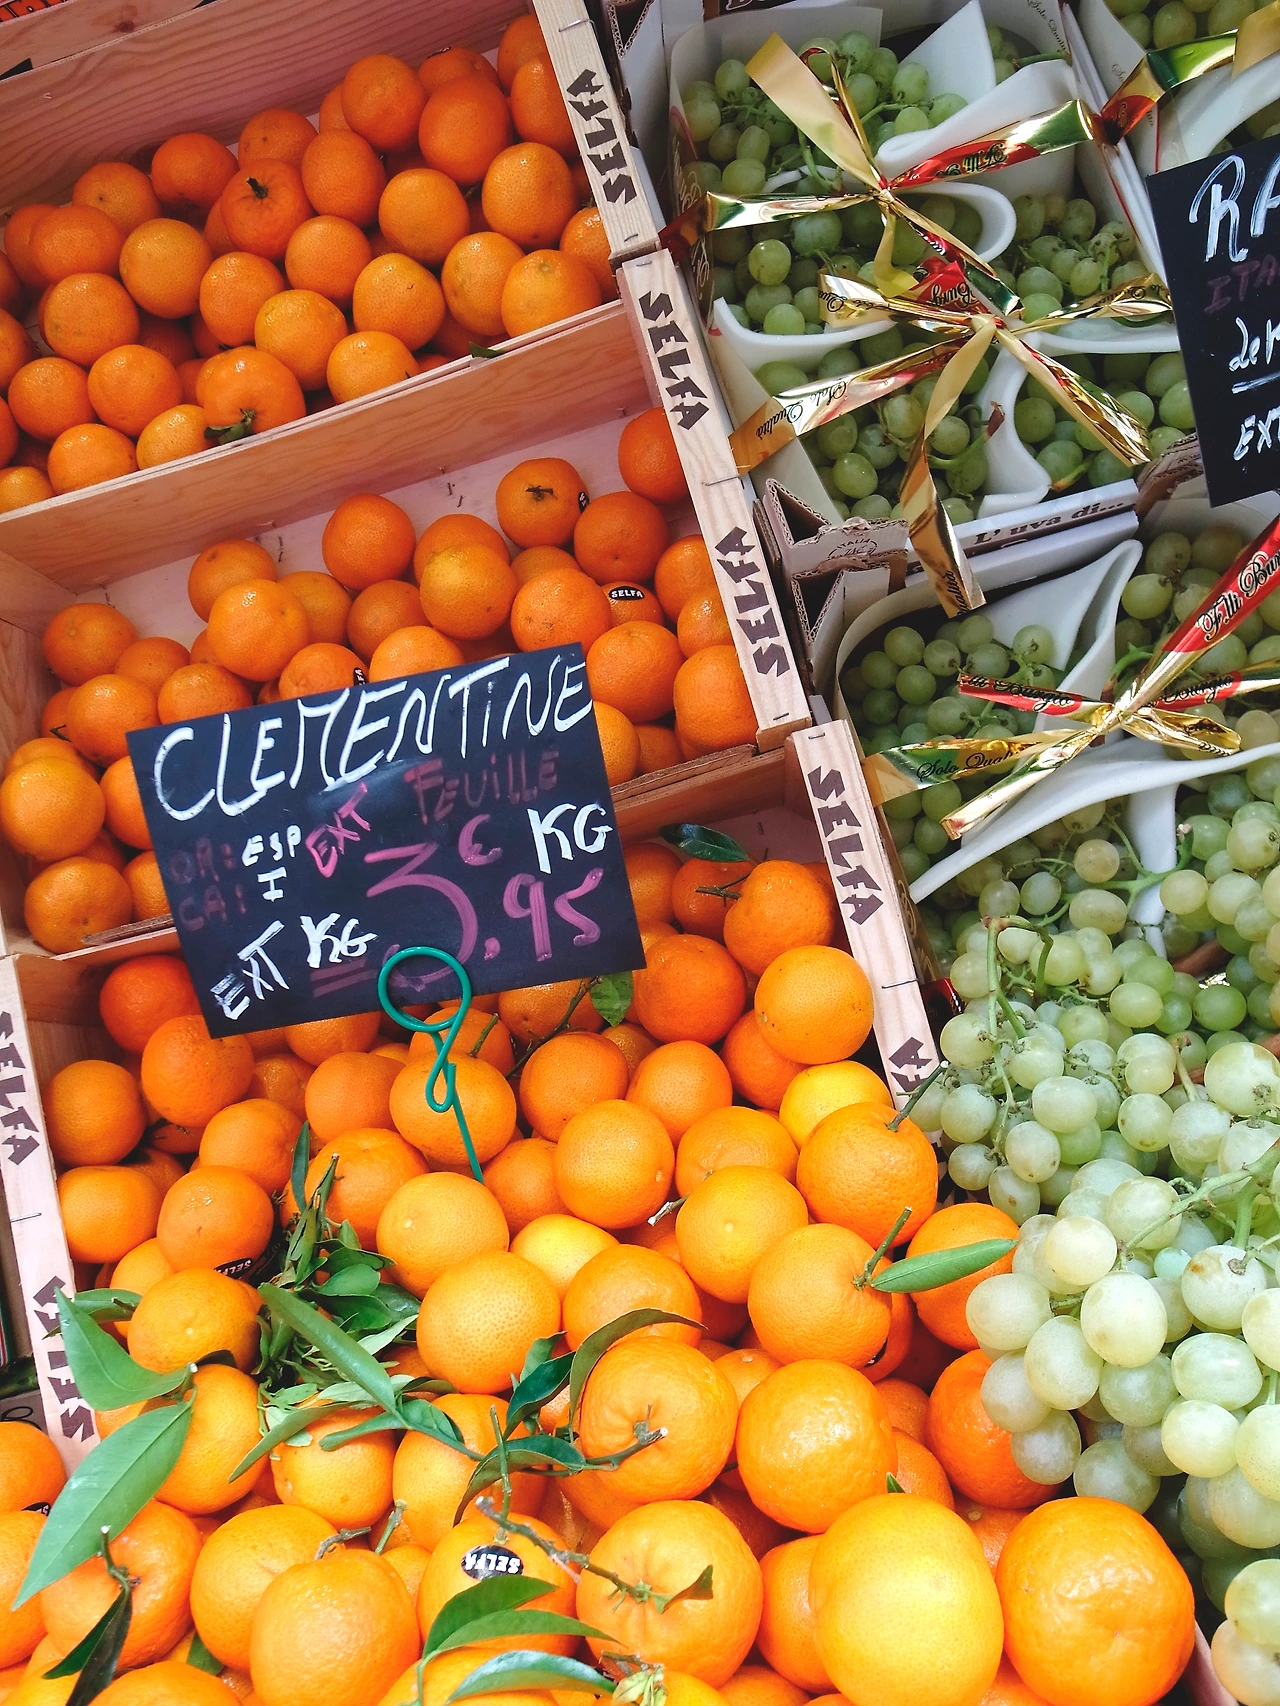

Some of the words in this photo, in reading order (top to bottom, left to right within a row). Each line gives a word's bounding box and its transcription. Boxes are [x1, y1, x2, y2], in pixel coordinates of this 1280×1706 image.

[567, 69, 637, 204] SELFA
[638, 291, 709, 430] SELFA
[1009, 515, 1062, 537] uva
[611, 589, 644, 599] SELFA
[714, 526, 790, 677] SELFA
[916, 759, 959, 782] Solo
[242, 825, 302, 867] ESP
[305, 783, 372, 877] EXT
[527, 803, 613, 874] KG
[807, 766, 884, 925] SELFA
[210, 920, 290, 1020] EXT
[464, 1552, 521, 1573] SELFA
